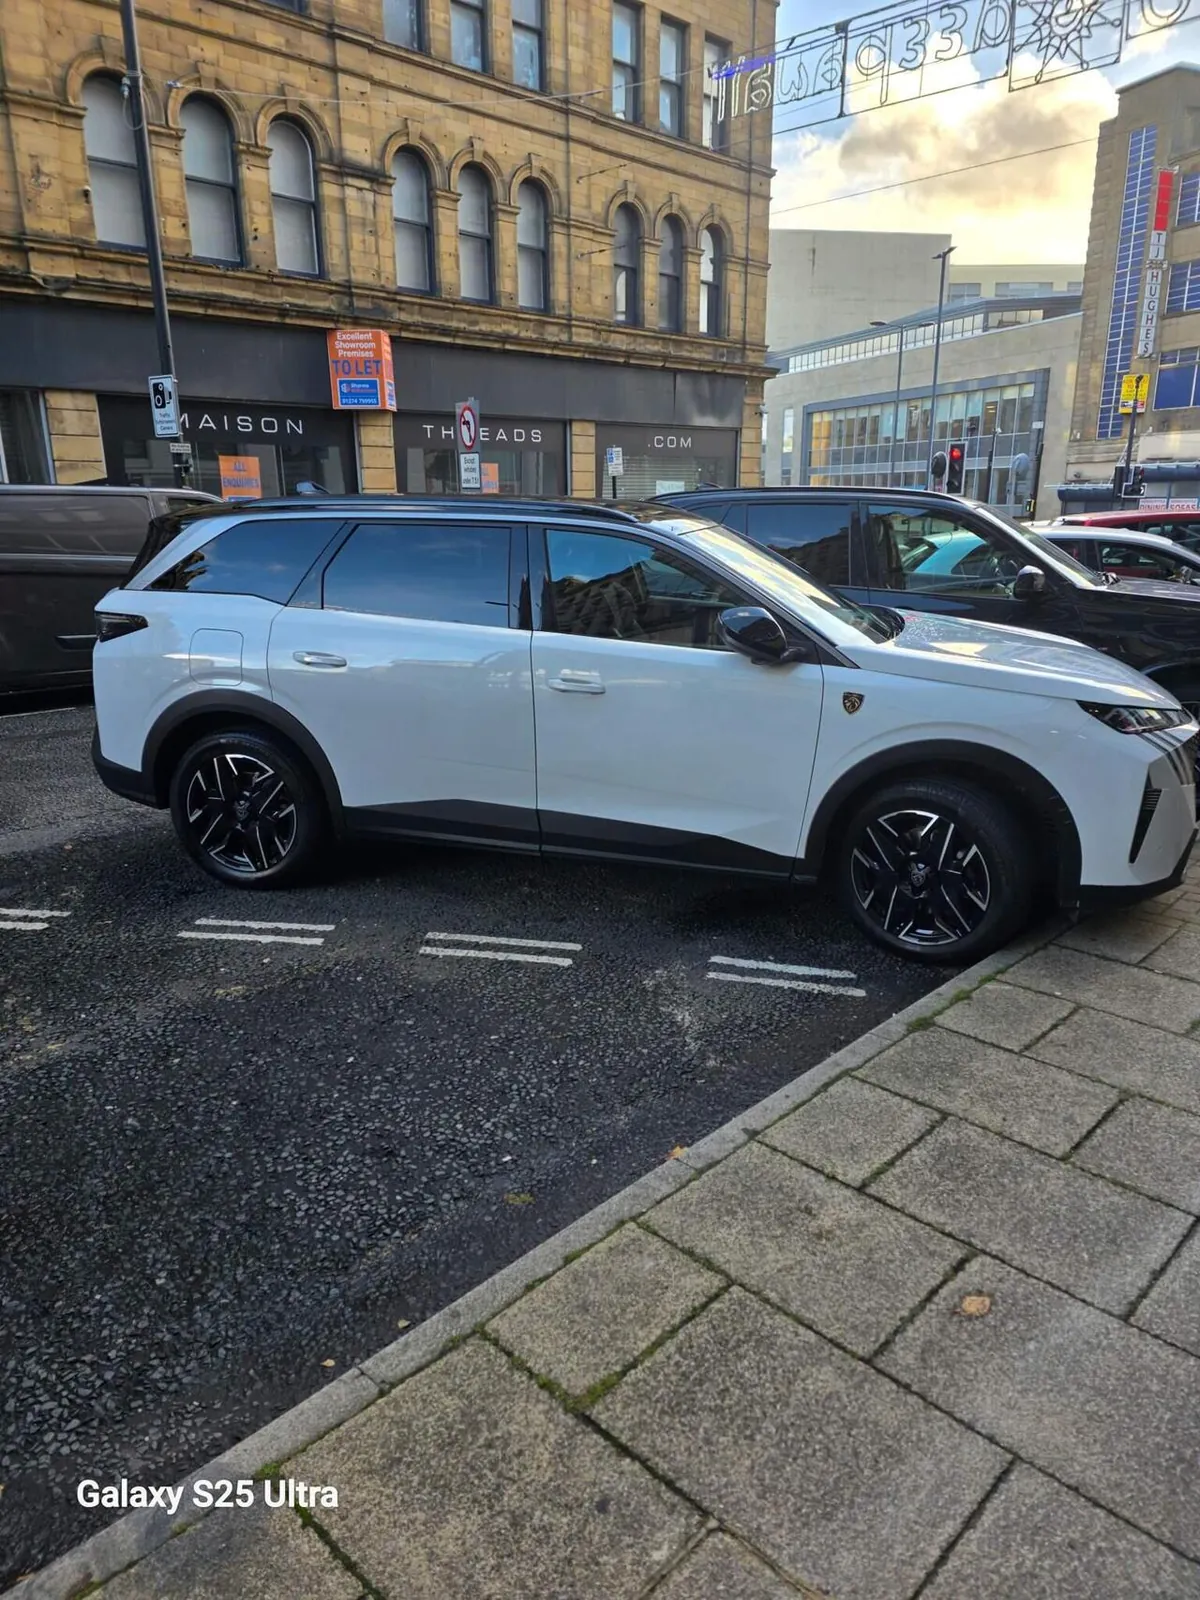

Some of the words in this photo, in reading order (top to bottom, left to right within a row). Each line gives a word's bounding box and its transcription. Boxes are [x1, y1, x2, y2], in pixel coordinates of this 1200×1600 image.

[1143, 270, 1159, 355] HUGHES
[336, 332, 372, 340] Excellent
[334, 341, 376, 349] Showroom
[338, 349, 374, 358] Premises
[332, 359, 351, 376] TO
[355, 359, 381, 375] LET
[180, 413, 304, 435] MAISON
[422, 424, 542, 443] THEADS
[647, 435, 692, 448] .COM
[233, 460, 246, 472] ALL
[222, 476, 260, 489] ENQUIRIES
